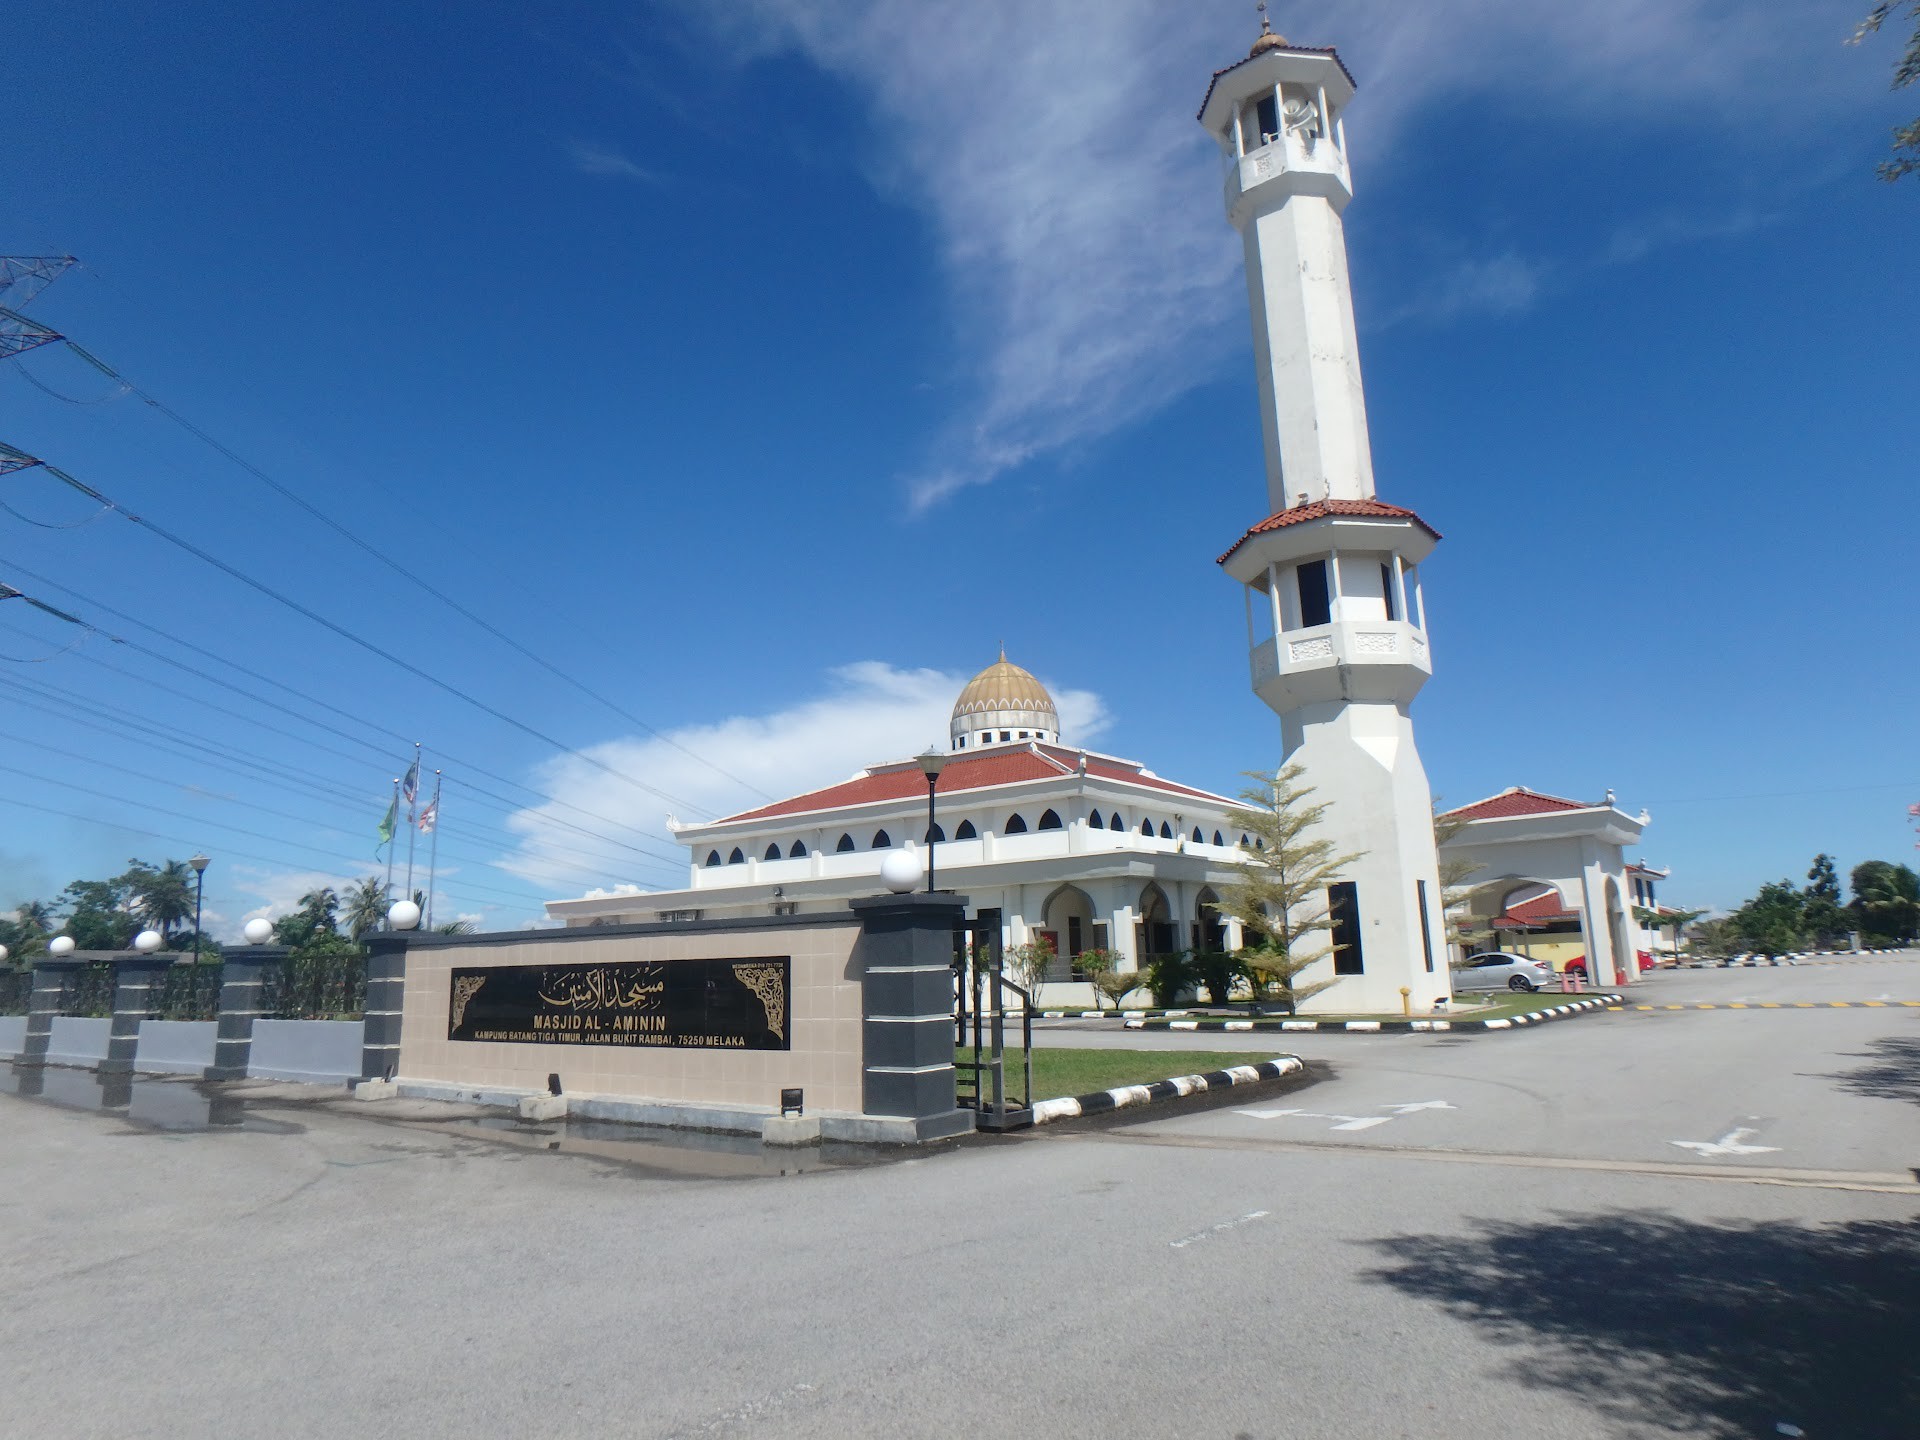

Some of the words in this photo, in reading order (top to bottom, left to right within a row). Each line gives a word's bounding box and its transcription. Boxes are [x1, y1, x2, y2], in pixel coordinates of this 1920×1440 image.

[533, 1015, 581, 1029] MASJID
[584, 1015, 601, 1030] AL
[613, 1015, 665, 1031] AMININ
[474, 1030, 508, 1039] KAMPUNG
[508, 1031, 537, 1040] BATANG
[538, 1032, 556, 1041] TIGA
[557, 1032, 583, 1043] TIMUR,
[585, 1033, 611, 1043] JALAN
[612, 1034, 640, 1044] BUKIT
[640, 1035, 675, 1046] RAMBAI,
[678, 1035, 705, 1045] 75250
[706, 1036, 745, 1046] MELAKA
